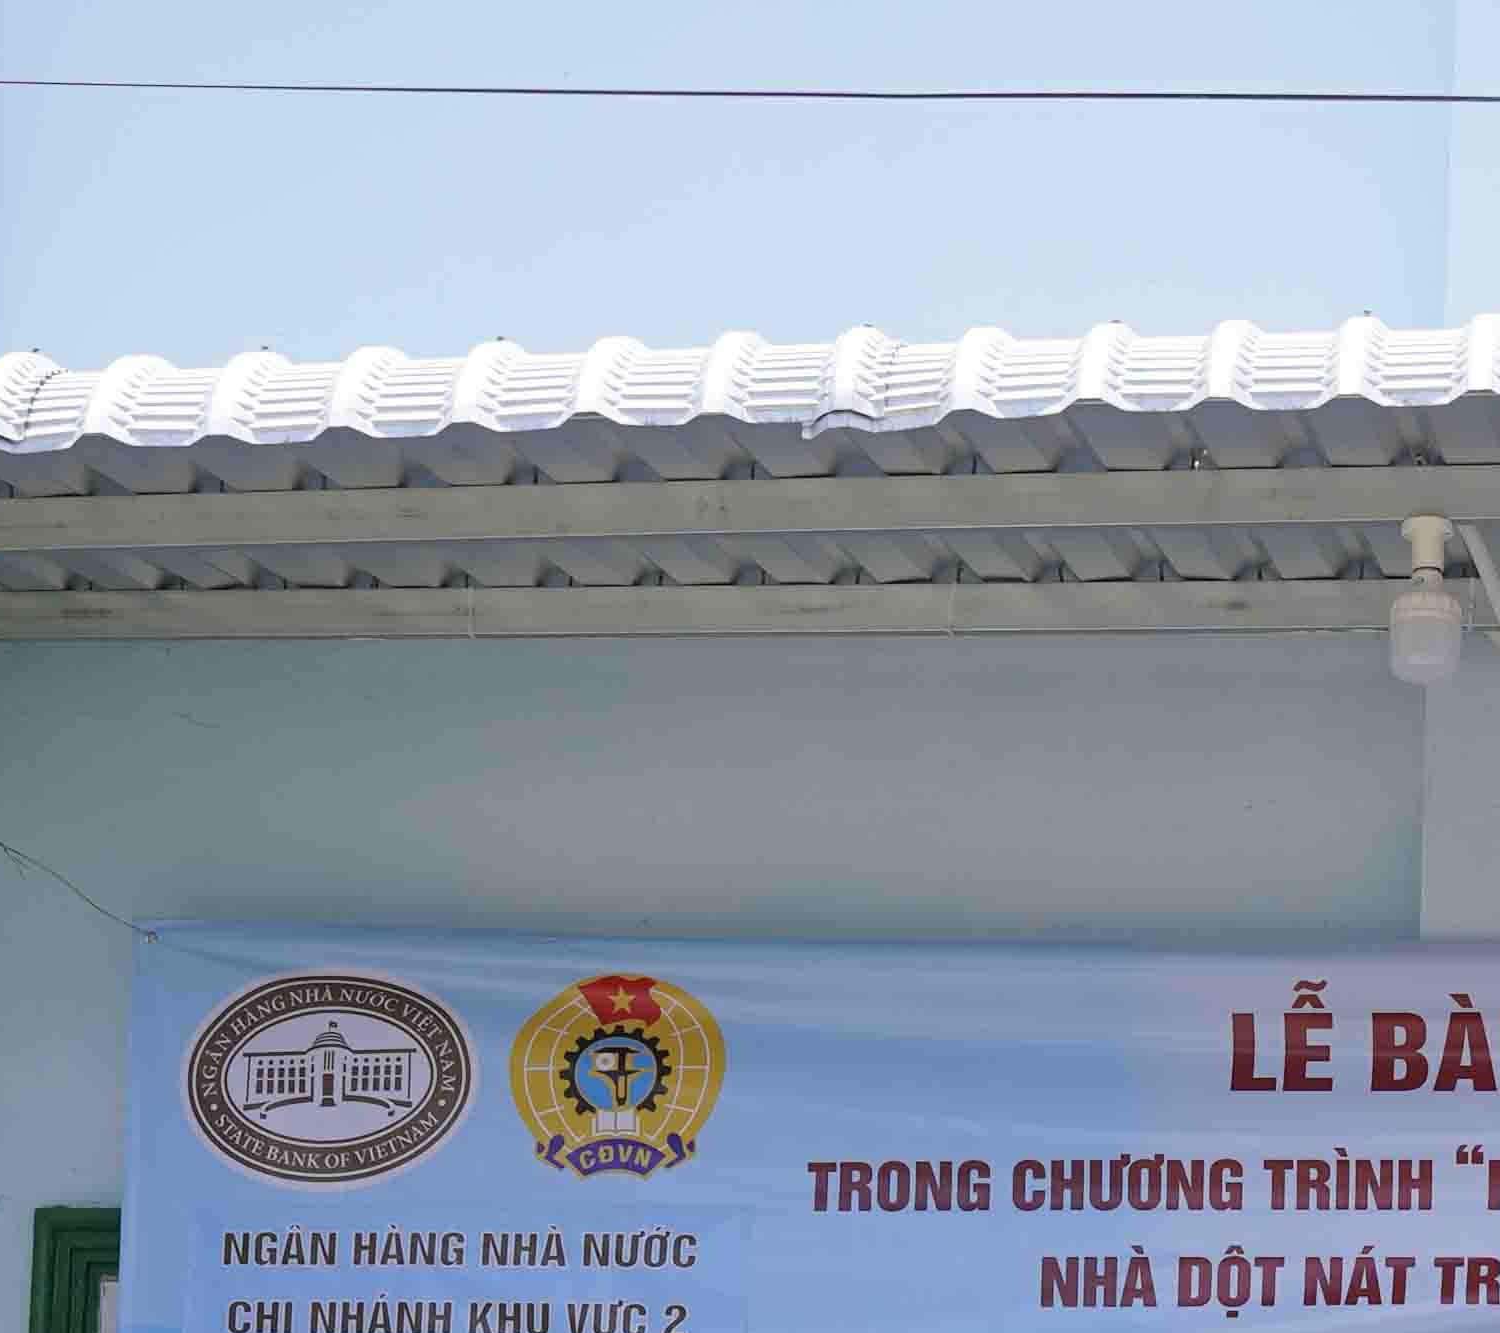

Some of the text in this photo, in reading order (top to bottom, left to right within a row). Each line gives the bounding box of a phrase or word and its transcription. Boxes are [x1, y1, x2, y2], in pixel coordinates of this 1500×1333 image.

[434, 1038, 457, 1095] NAM
[1229, 980, 1334, 1093] LỄ
[214, 1111, 440, 1170] STATE BANK OF VIETNAM
[808, 1160, 991, 1212] TRONG
[1012, 1152, 1244, 1212] CHƯƠNG
[1269, 1146, 1433, 1212] TRÌNH
[222, 1224, 698, 1269] NGÂN HÀNG NHÀ NƯỚC
[1040, 1246, 1157, 1308] NHÀ
[1178, 1245, 1284, 1319] DỘT
[1303, 1245, 1416, 1307] NÁT
